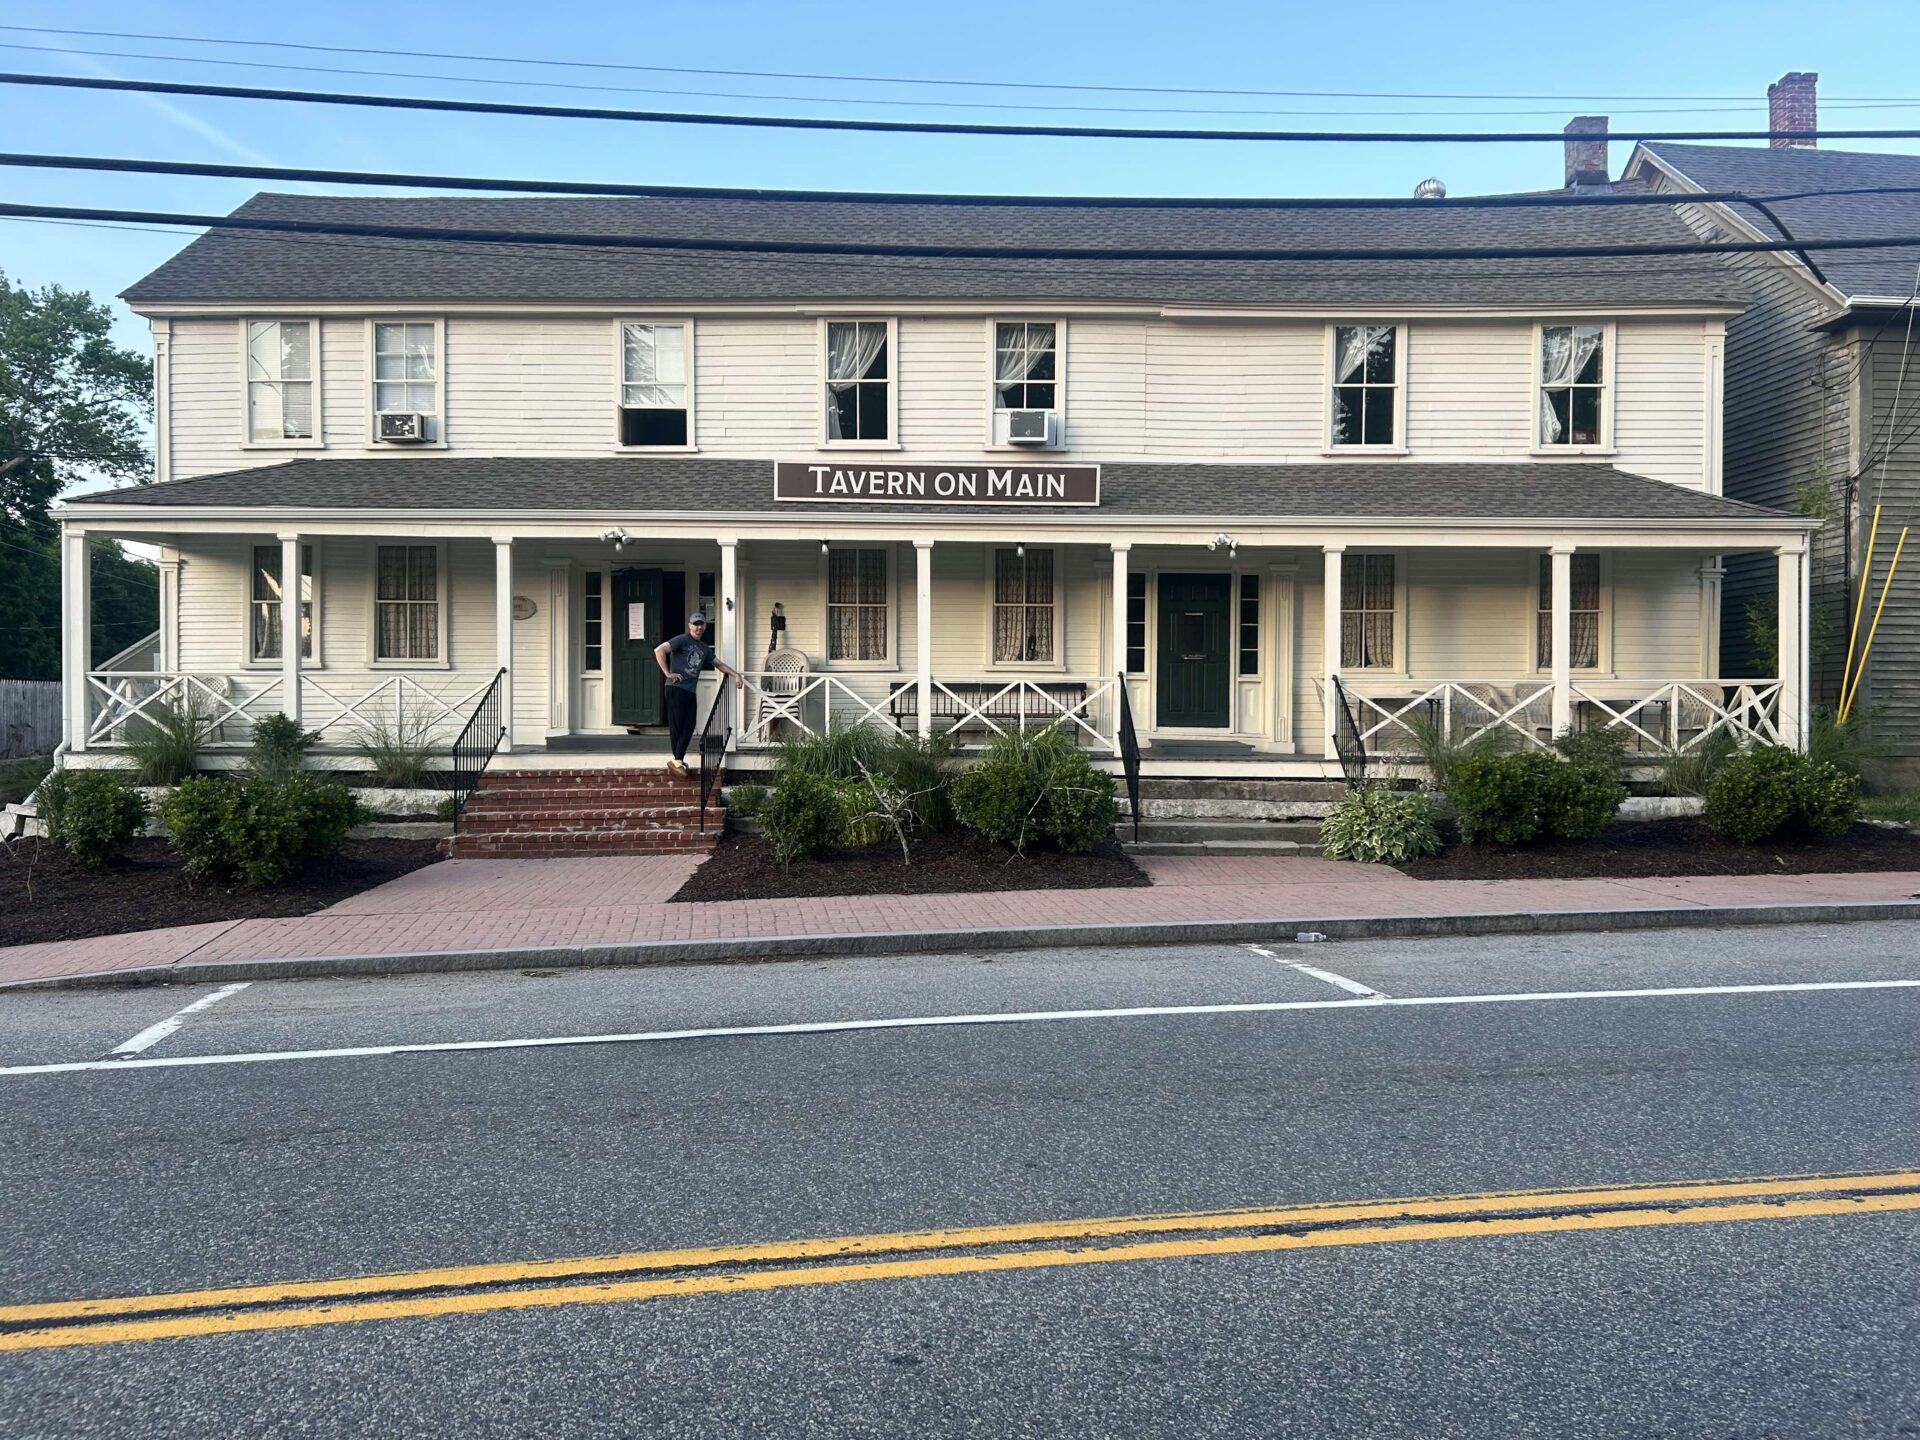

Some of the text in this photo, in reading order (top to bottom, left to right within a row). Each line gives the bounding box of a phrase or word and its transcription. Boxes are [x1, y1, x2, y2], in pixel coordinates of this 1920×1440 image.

[808, 466, 1065, 497] TAVERN ON MAIN
